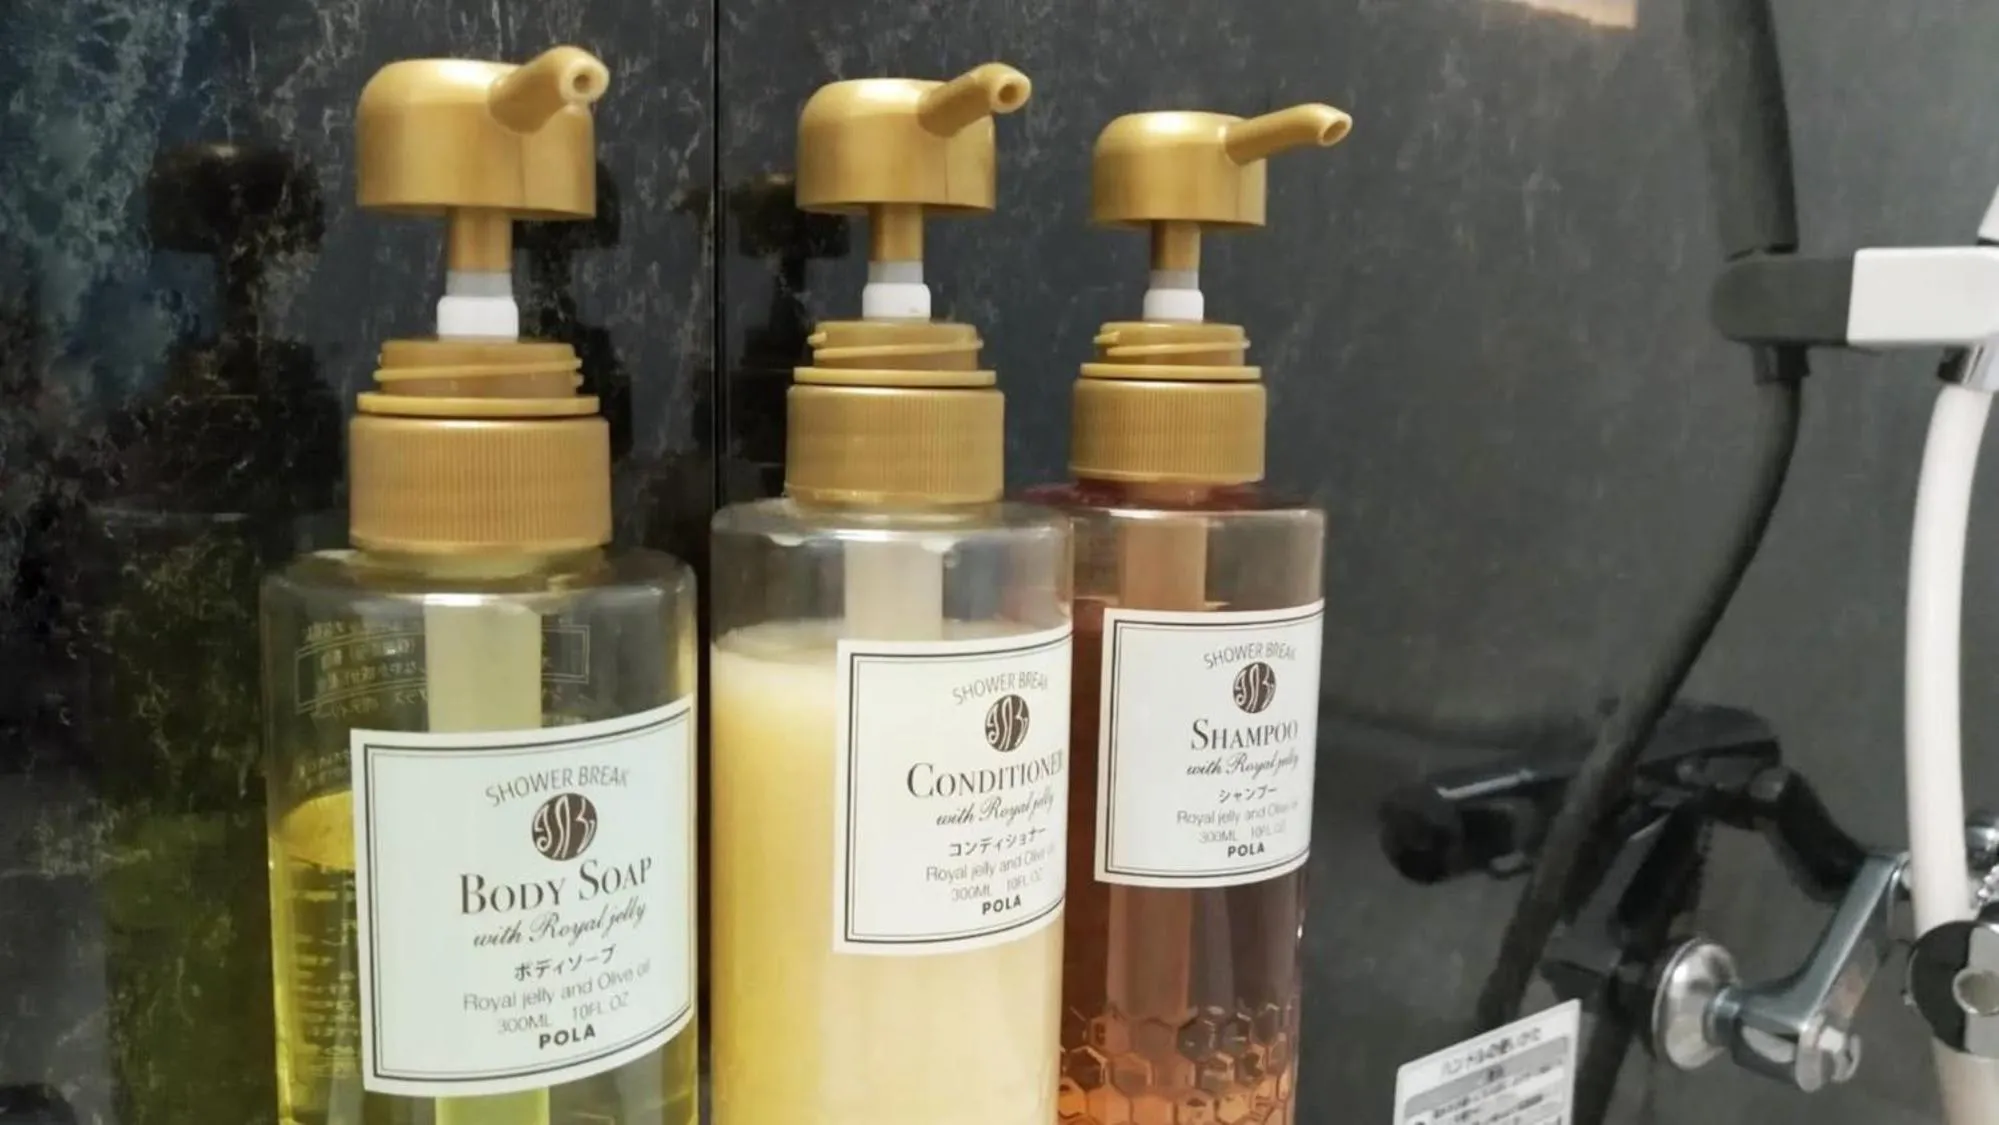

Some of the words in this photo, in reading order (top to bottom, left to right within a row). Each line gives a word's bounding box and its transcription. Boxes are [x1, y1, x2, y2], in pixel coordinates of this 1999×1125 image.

[1204, 642, 1263, 669] SHOWER
[952, 673, 1015, 706] SHOWER
[1191, 718, 1298, 751] SHAMPOO
[1186, 757, 1222, 776] with
[1226, 750, 1278, 780] Royal
[485, 767, 573, 807] SHOWER
[578, 765, 629, 788] BREAK
[1219, 784, 1277, 804] シャンプー
[936, 803, 975, 826] with
[979, 791, 1034, 826] Royal
[1176, 810, 1215, 826] Royal
[1217, 808, 1240, 826] jelly
[1245, 805, 1265, 821] and
[949, 826, 1046, 857] コンディショナー
[1199, 829, 1237, 844] 300ML
[1227, 842, 1265, 858] POLA
[926, 864, 967, 883] Royal
[971, 861, 996, 880] jelly
[999, 857, 1022, 872] and
[460, 873, 566, 915] BODY
[578, 856, 652, 900] SOAP
[951, 884, 991, 901] 300ML
[982, 894, 1022, 915] POLA
[473, 919, 522, 947] with
[529, 904, 608, 947] Royal
[602, 895, 646, 940] jelly
[515, 944, 616, 981] ボディソープ
[463, 992, 516, 1013] Royal
[522, 987, 554, 1011] jelly
[560, 978, 593, 999] and
[597, 966, 634, 990] Olive
[498, 1013, 552, 1035] 300ML
[572, 1004, 603, 1022] 10FL
[609, 990, 630, 1012] OZ
[539, 1024, 596, 1050] POLA
